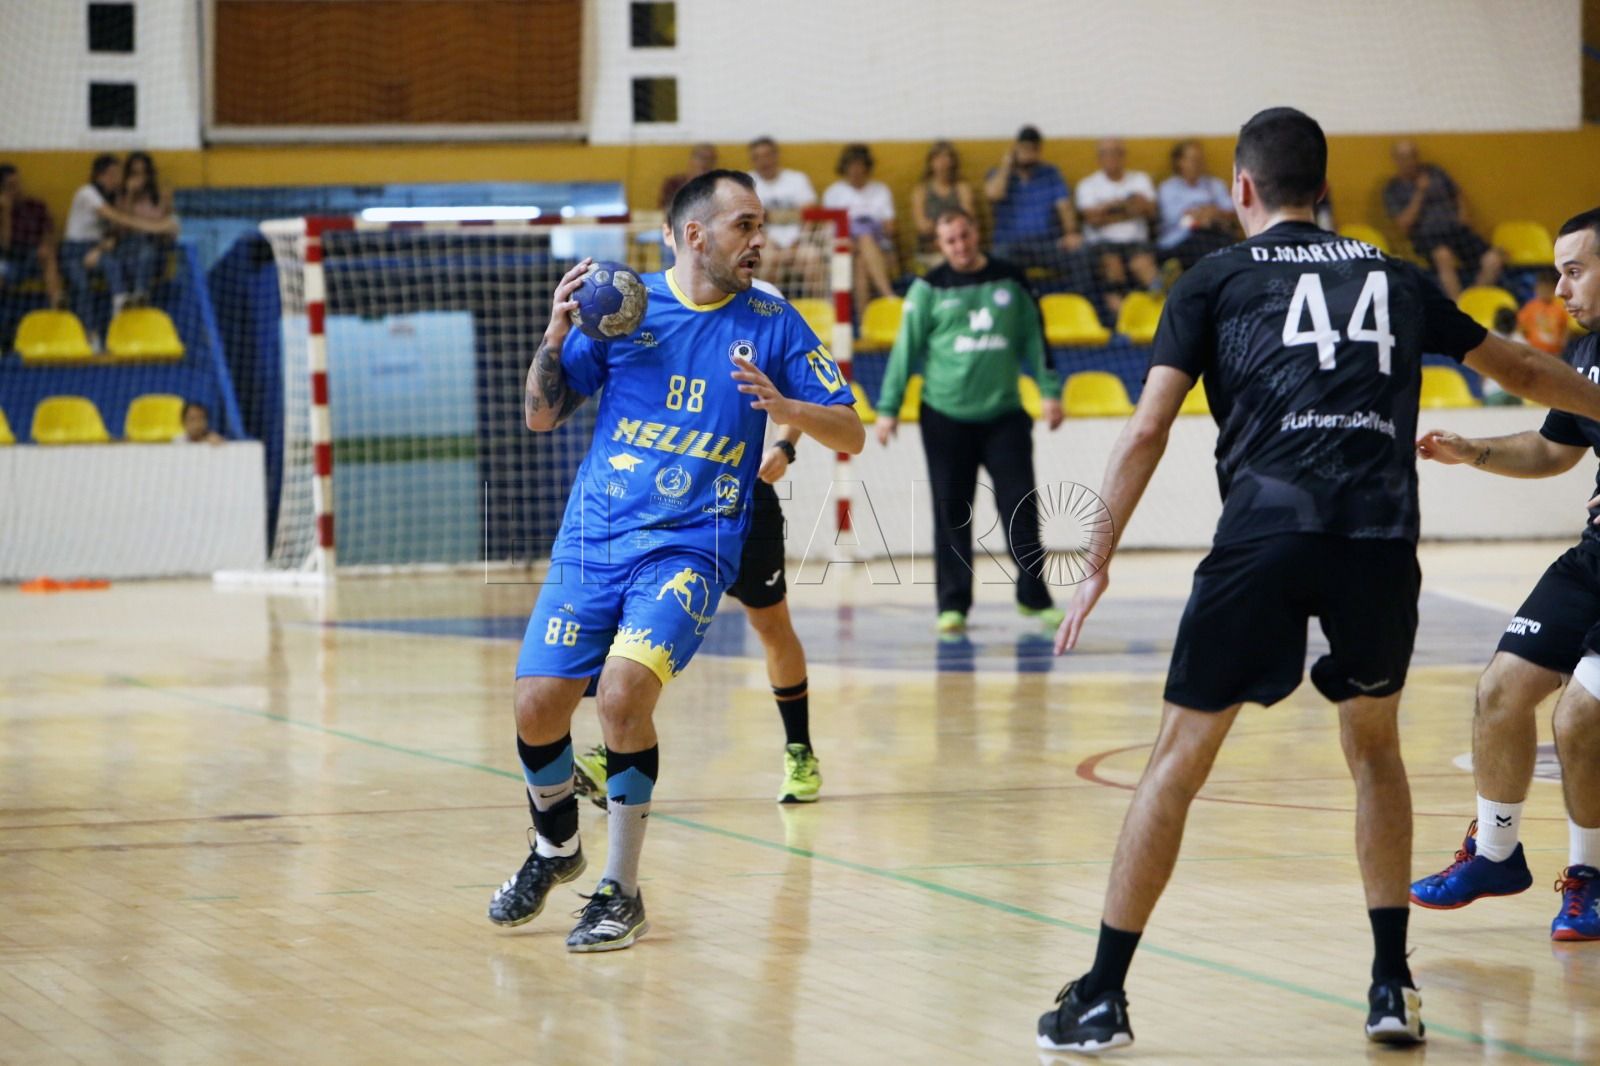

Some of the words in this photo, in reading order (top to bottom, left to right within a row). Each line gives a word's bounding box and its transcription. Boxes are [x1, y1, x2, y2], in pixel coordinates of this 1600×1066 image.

[1282, 270, 1396, 376] 44
[666, 375, 707, 413] 88
[611, 417, 747, 467] MELILLA
[545, 617, 581, 647] 88
